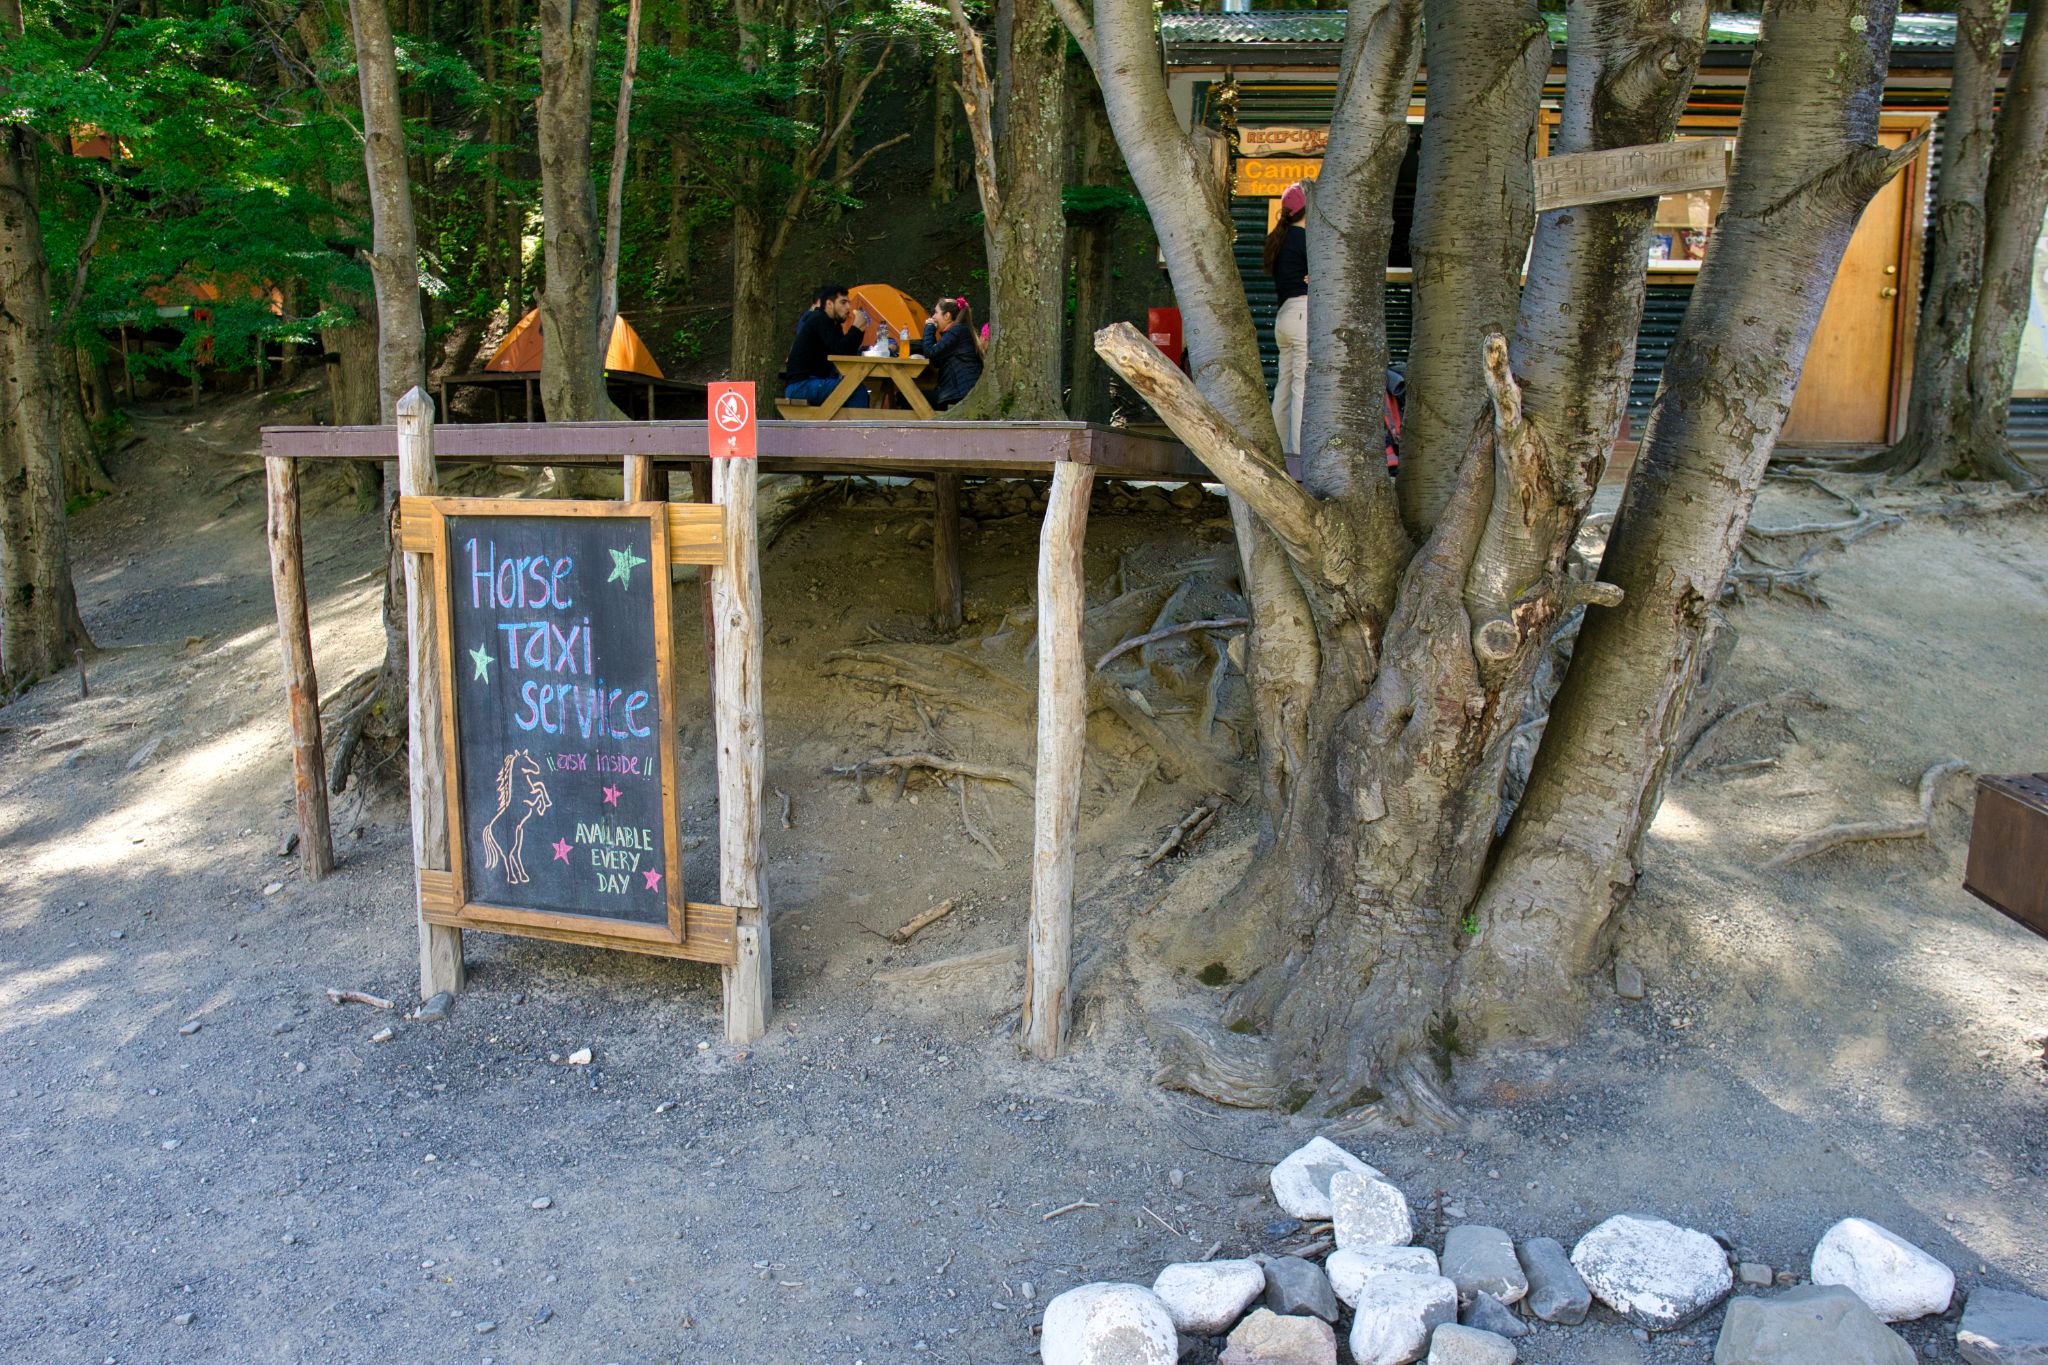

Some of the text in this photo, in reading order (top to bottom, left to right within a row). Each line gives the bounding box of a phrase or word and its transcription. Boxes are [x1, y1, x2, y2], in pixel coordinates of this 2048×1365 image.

[465, 538, 573, 609] Horse
[575, 820, 654, 851] AVAILABLE
[591, 848, 641, 873] EVERY
[596, 872, 631, 894] DAY
